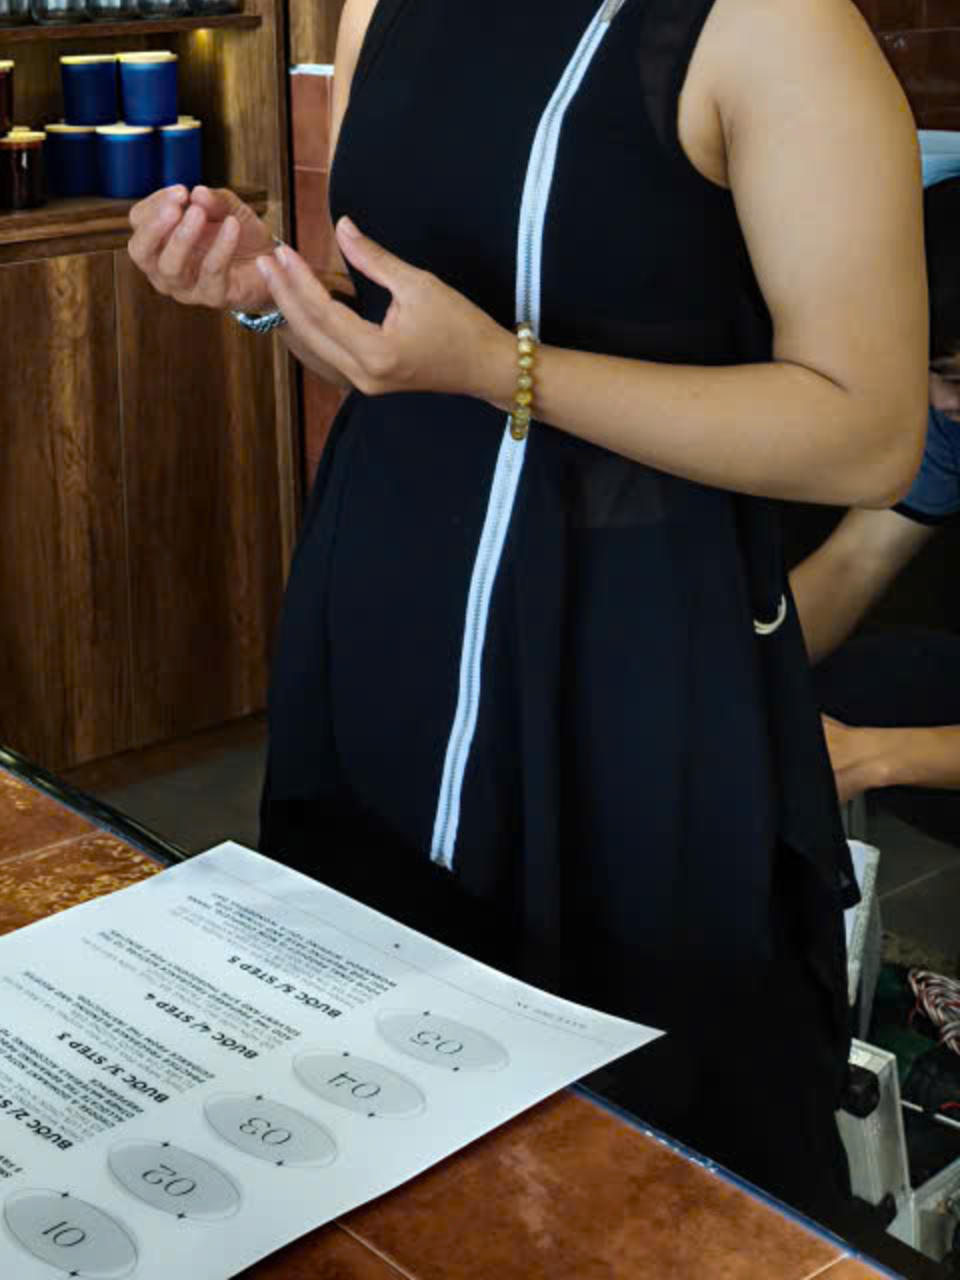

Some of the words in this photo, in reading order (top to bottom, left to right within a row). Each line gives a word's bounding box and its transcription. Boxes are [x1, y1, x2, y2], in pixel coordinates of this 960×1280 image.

[238, 963, 279, 985] STEP
[155, 1000, 195, 1024] STEP
[294, 991, 343, 1019] BƯỚC
[68, 1040, 108, 1066] STEP
[210, 1031, 259, 1060] BƯỚC
[409, 1030, 465, 1056] 05
[121, 1074, 170, 1104] BƯỚC
[327, 1071, 382, 1099] 04
[25, 1118, 74, 1151] BƯỚC
[238, 1116, 293, 1146] 03
[140, 1163, 198, 1197] 02
[40, 1220, 87, 1248] 01
